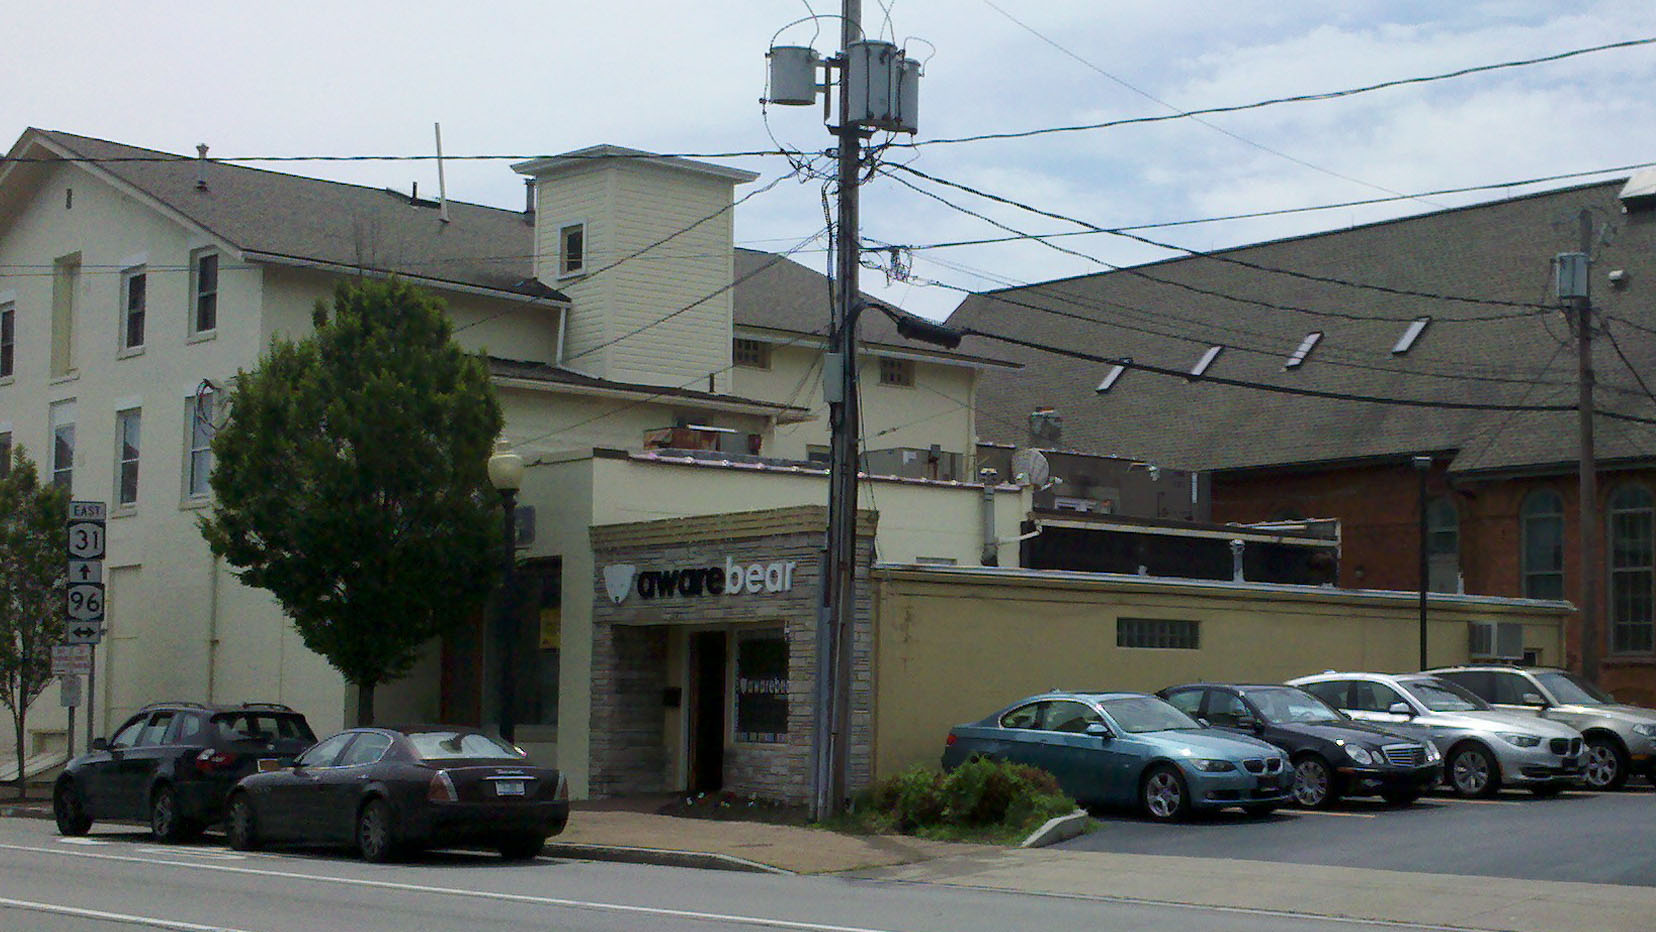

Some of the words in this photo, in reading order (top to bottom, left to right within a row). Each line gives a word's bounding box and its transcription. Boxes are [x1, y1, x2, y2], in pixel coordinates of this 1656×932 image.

[73, 504, 101, 517] EAST
[75, 529, 98, 551] 31
[637, 555, 796, 599] awarebear
[70, 591, 100, 612] 96
